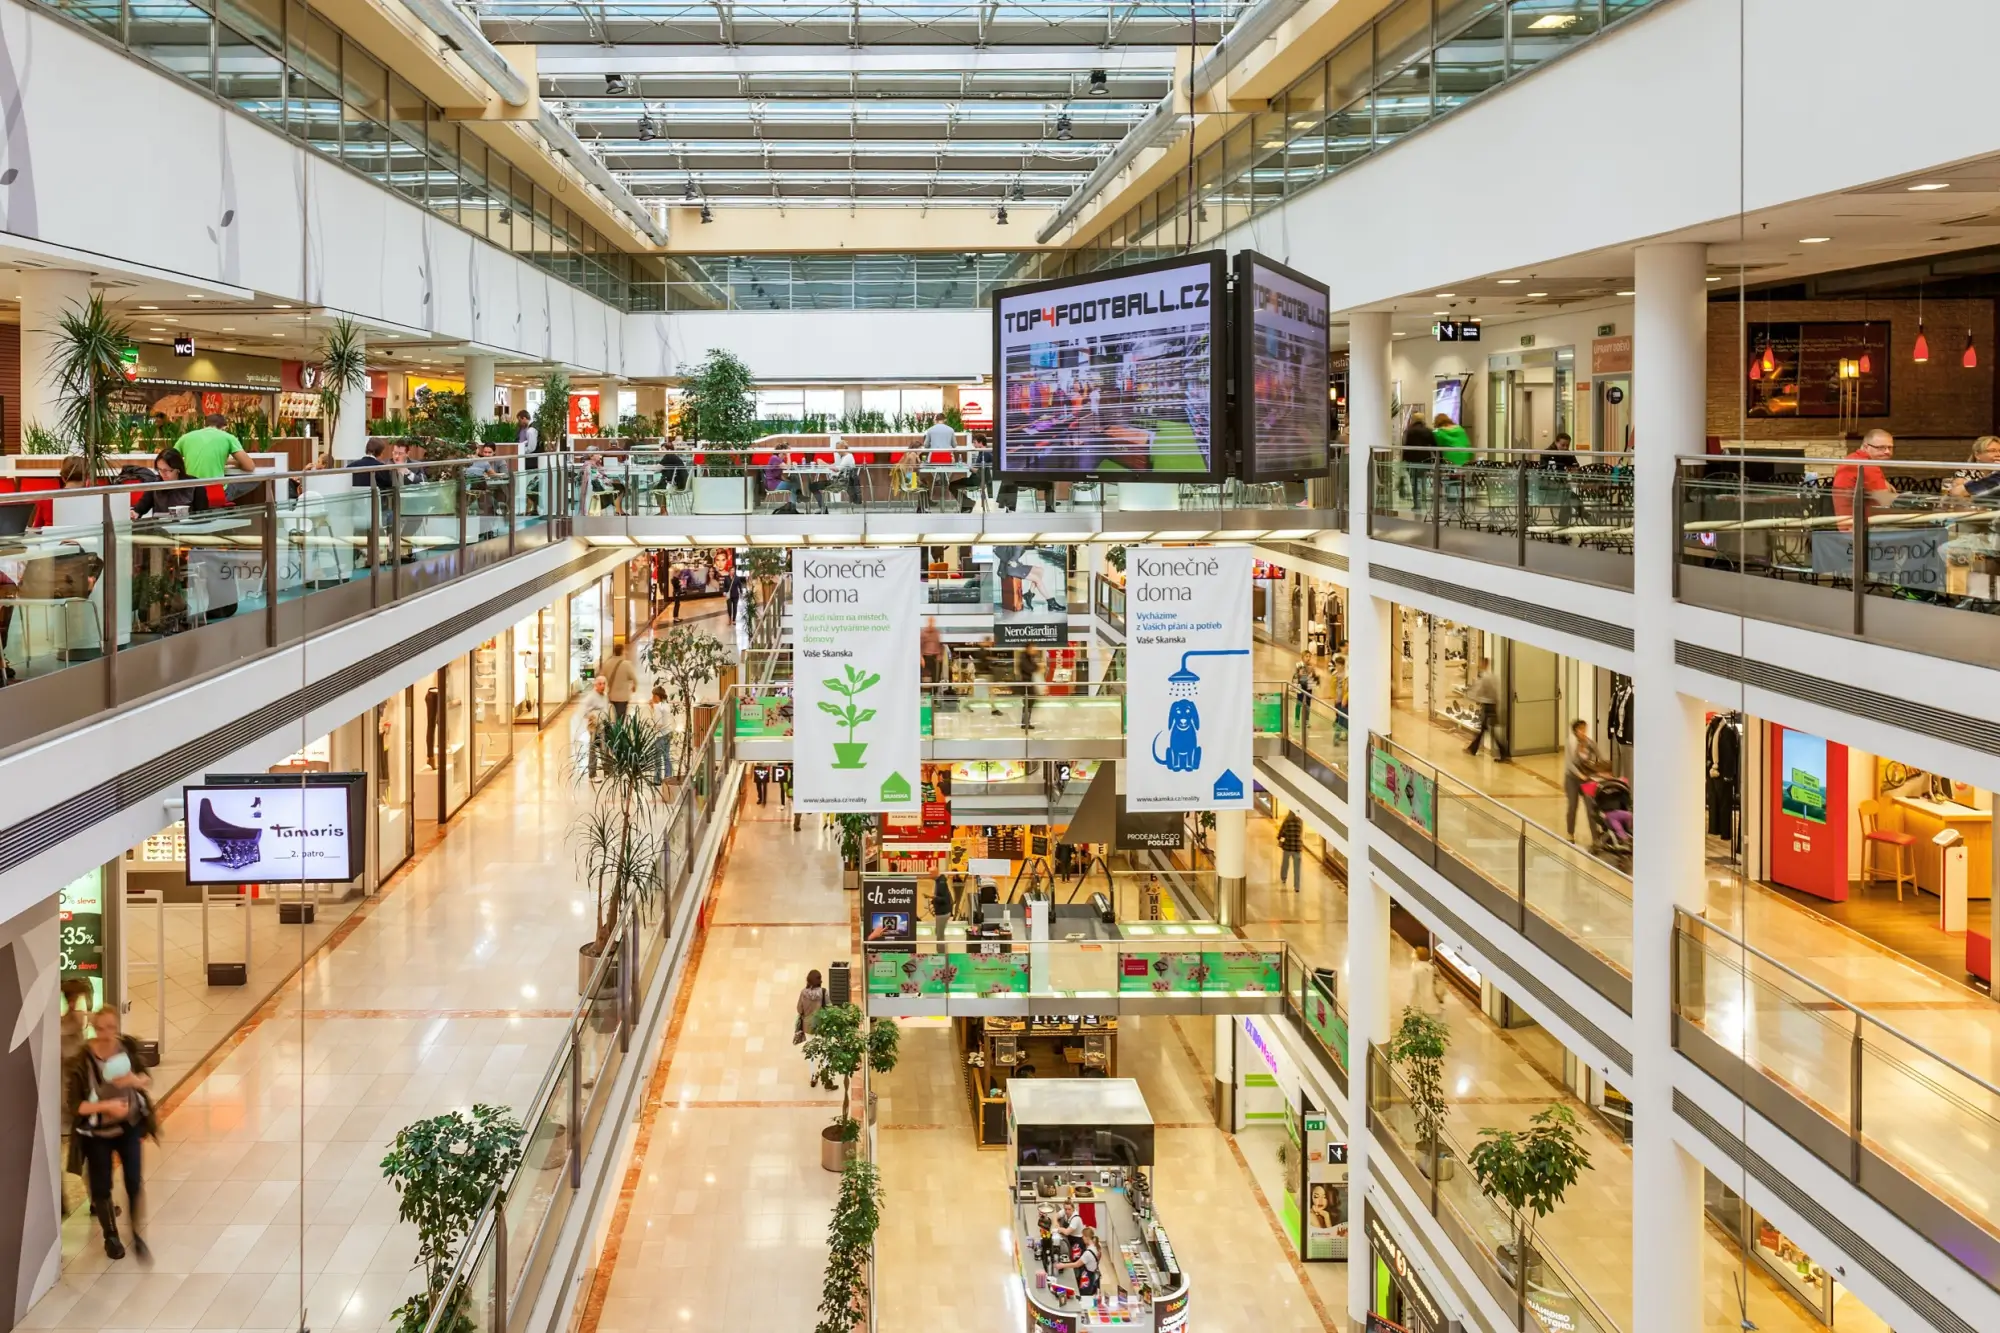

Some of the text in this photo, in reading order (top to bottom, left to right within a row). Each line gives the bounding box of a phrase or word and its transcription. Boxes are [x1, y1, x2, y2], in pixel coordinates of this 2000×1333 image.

[1004, 282, 1210, 333] TOP4FOOTBALL.CZ
[175, 344, 192, 354] WC
[803, 559, 886, 579] Konečně
[1137, 557, 1219, 577] Konečně
[803, 584, 859, 604] doma
[1137, 582, 1192, 602] doma
[1136, 612, 1177, 620] Vycházíme
[871, 623, 891, 632] nové
[1004, 624, 1058, 637] NeroGiardini
[1142, 622, 1166, 631] Vašich
[1168, 622, 1188, 632] přání
[1196, 621, 1222, 632] potřeb
[803, 636, 834, 644] domovy
[1136, 635, 1187, 644] Vaše Skanska
[803, 650, 853, 658] Vaše Skanska
[775, 768, 785, 781] P
[1060, 766, 1070, 780] 2
[1136, 795, 1200, 803] www.skanska.cz/reality
[270, 824, 344, 838] Tamaris
[986, 827, 993, 837] 1
[1147, 838, 1175, 846] PODLAŽÍ
[291, 850, 325, 860] 2. patro
[867, 885, 886, 904] ch.
[887, 887, 913, 895] chodím
[76, 897, 97, 905] sleva
[887, 896, 911, 904] zdravě
[78, 961, 98, 970] sleva
